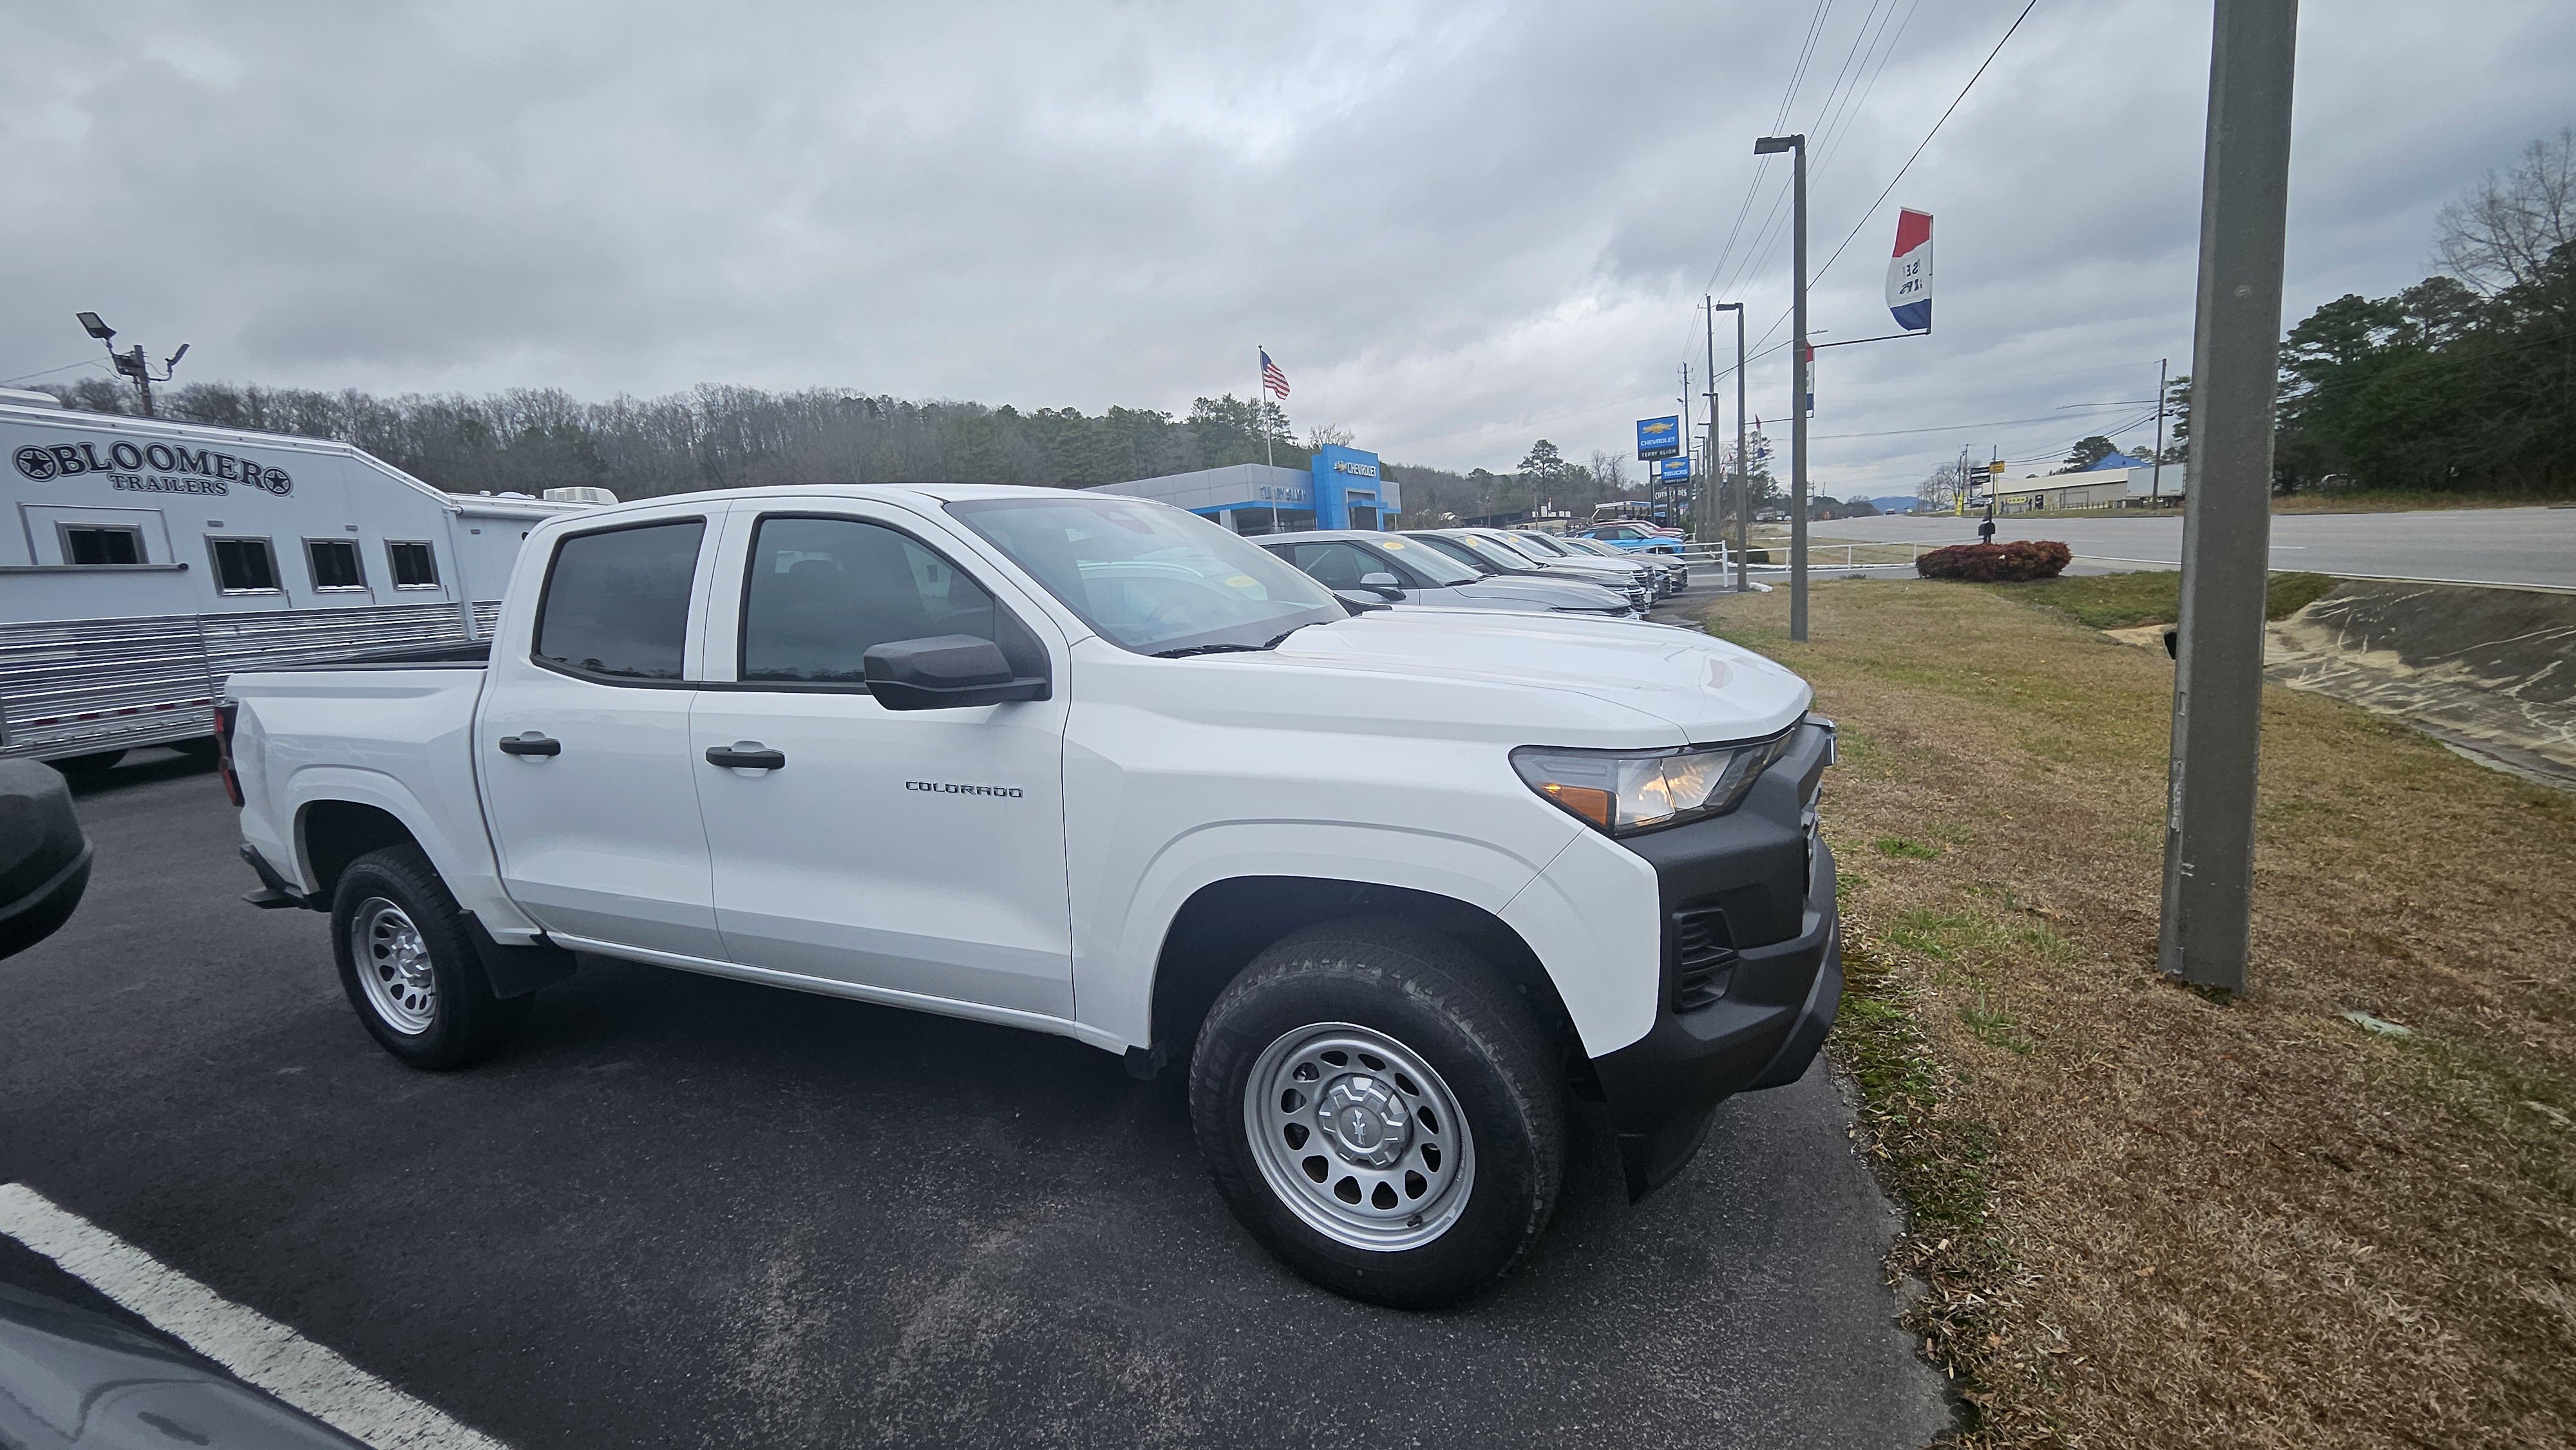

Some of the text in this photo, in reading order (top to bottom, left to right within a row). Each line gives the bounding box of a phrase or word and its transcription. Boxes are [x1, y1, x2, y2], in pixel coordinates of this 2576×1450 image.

[1641, 437, 1676, 446] CHEVROLET
[46, 441, 265, 489] BLOOMER
[1347, 462, 1376, 477] CHEVROLET
[110, 475, 228, 495] TRAILERS
[905, 780, 1023, 798] COLORADO
